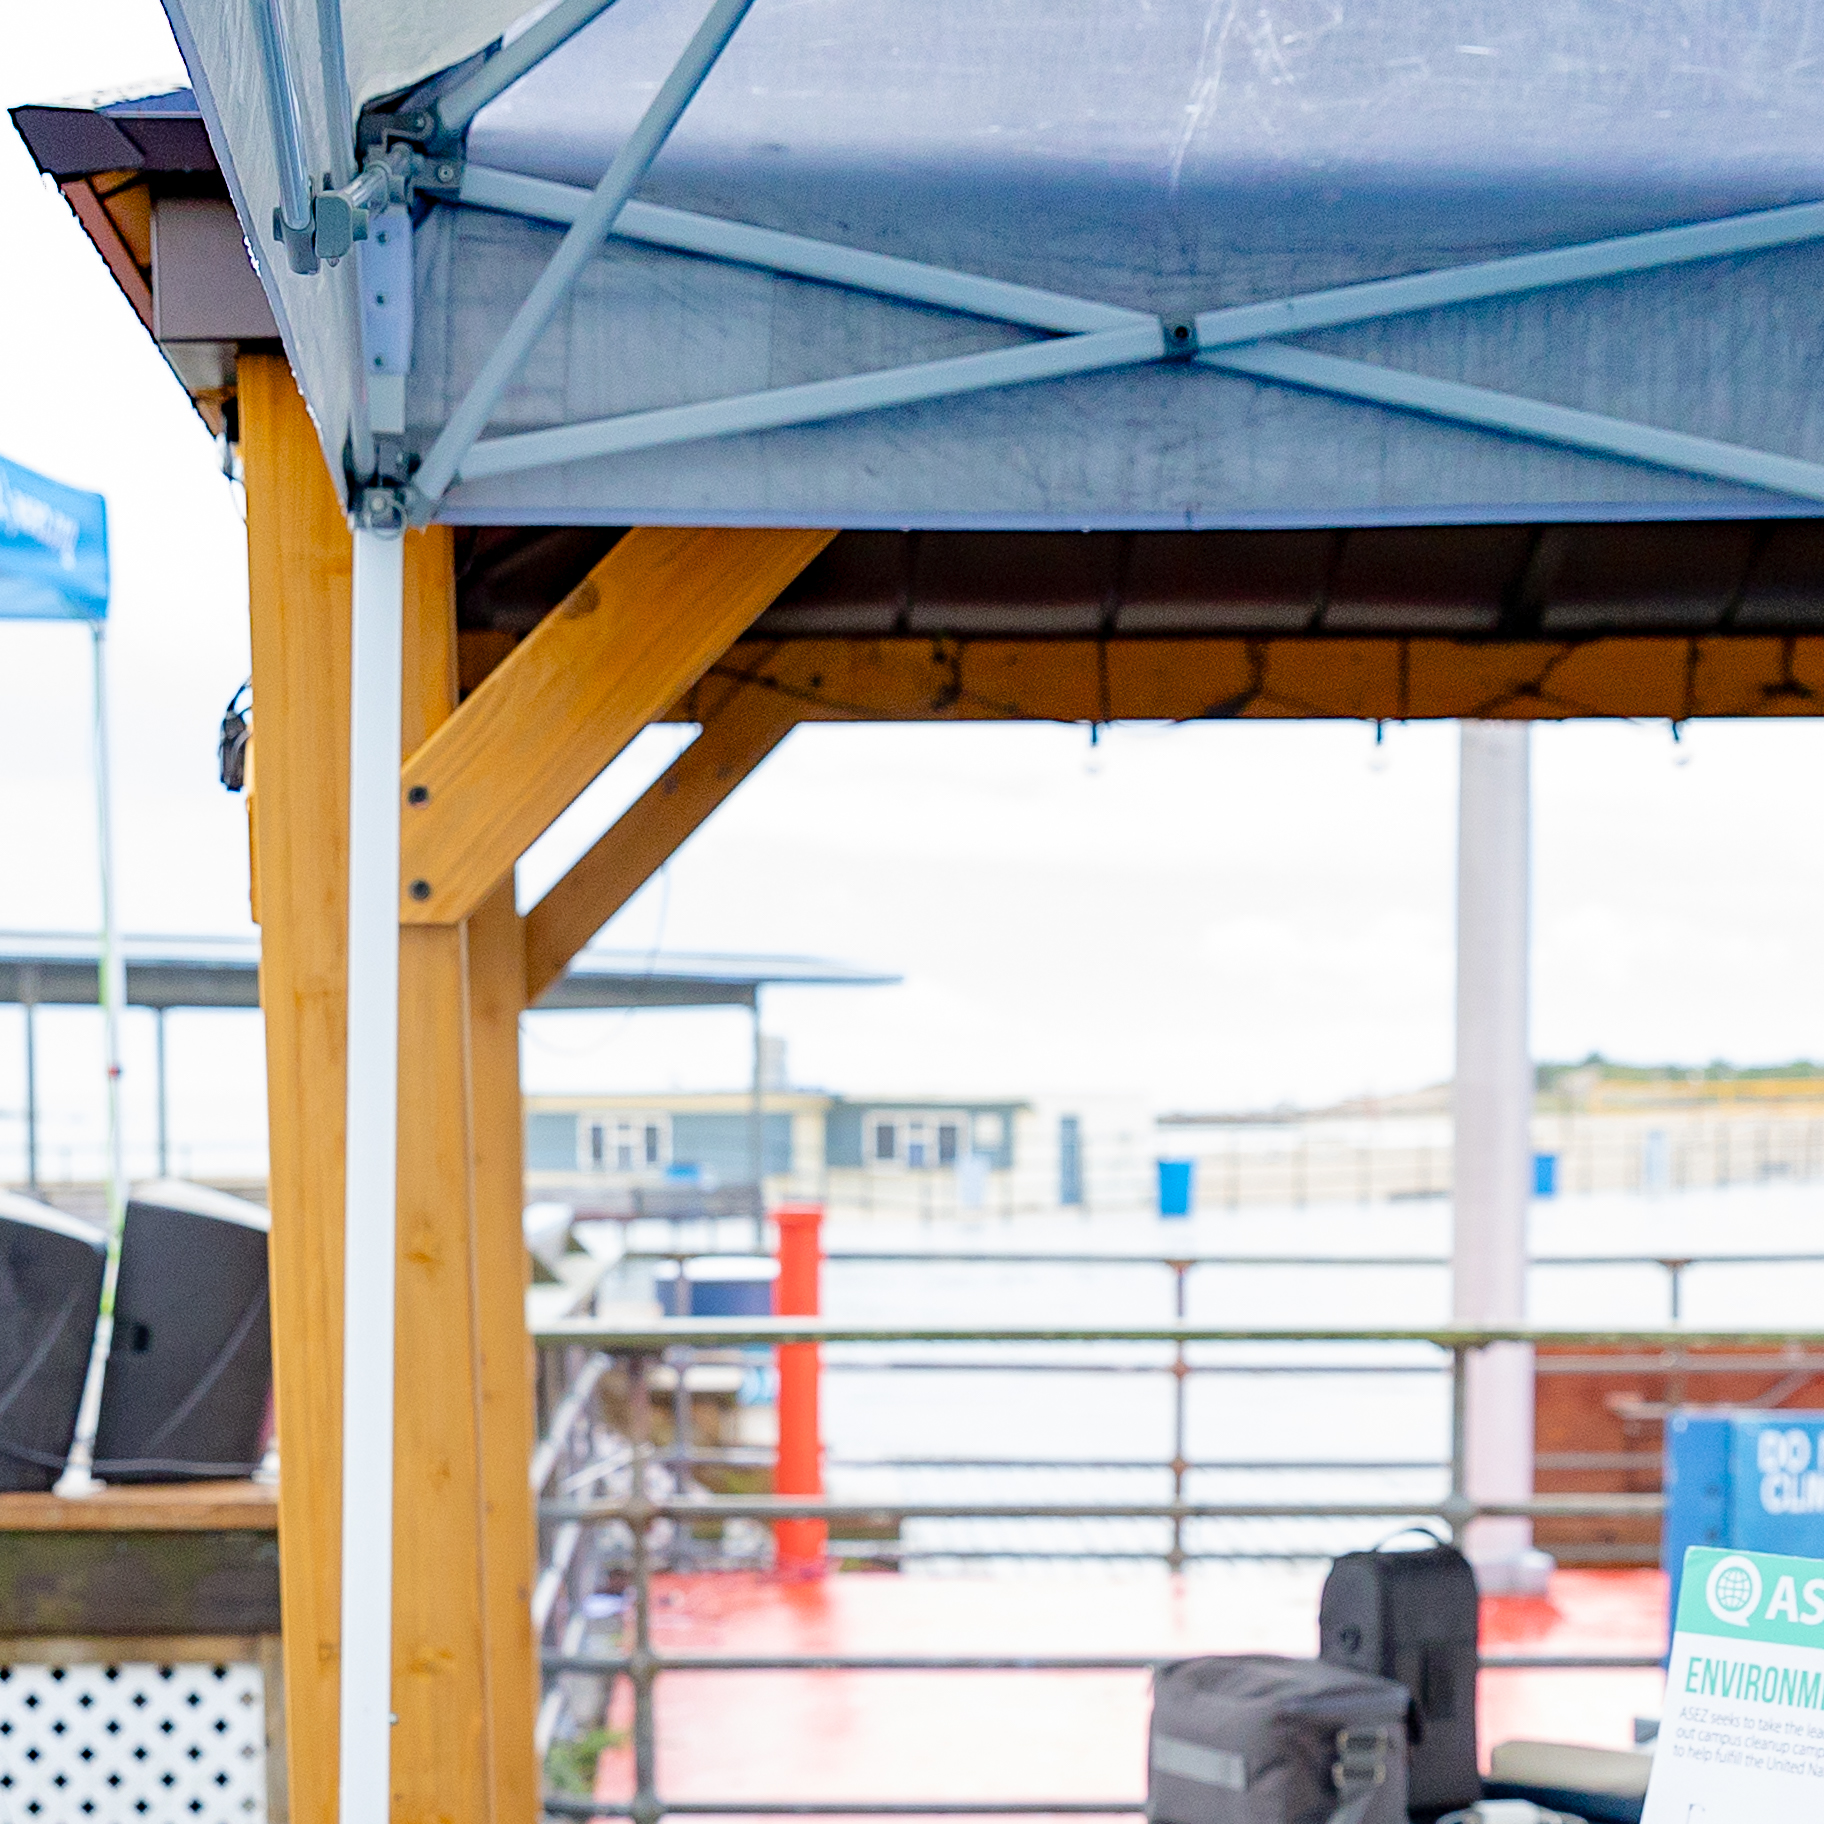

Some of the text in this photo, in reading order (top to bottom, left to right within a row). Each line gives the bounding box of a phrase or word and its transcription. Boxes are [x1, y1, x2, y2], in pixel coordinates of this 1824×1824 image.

[1758, 1430, 1810, 1473] DO
[1679, 1706, 1708, 1723] ASEZ
[1711, 1711, 1740, 1728] seeks
[1744, 1717, 1755, 1729] to
[1758, 1718, 1781, 1733] take
[1784, 1721, 1804, 1736] the
[1676, 1727, 1695, 1740] out
[1698, 1730, 1742, 1748] campus
[1744, 1735, 1790, 1755] cleanup
[1673, 1745, 1685, 1757] to
[1687, 1746, 1712, 1762] help
[1715, 1748, 1743, 1765] fulfill
[1745, 1753, 1764, 1769] the
[1766, 1756, 1805, 1775] United
